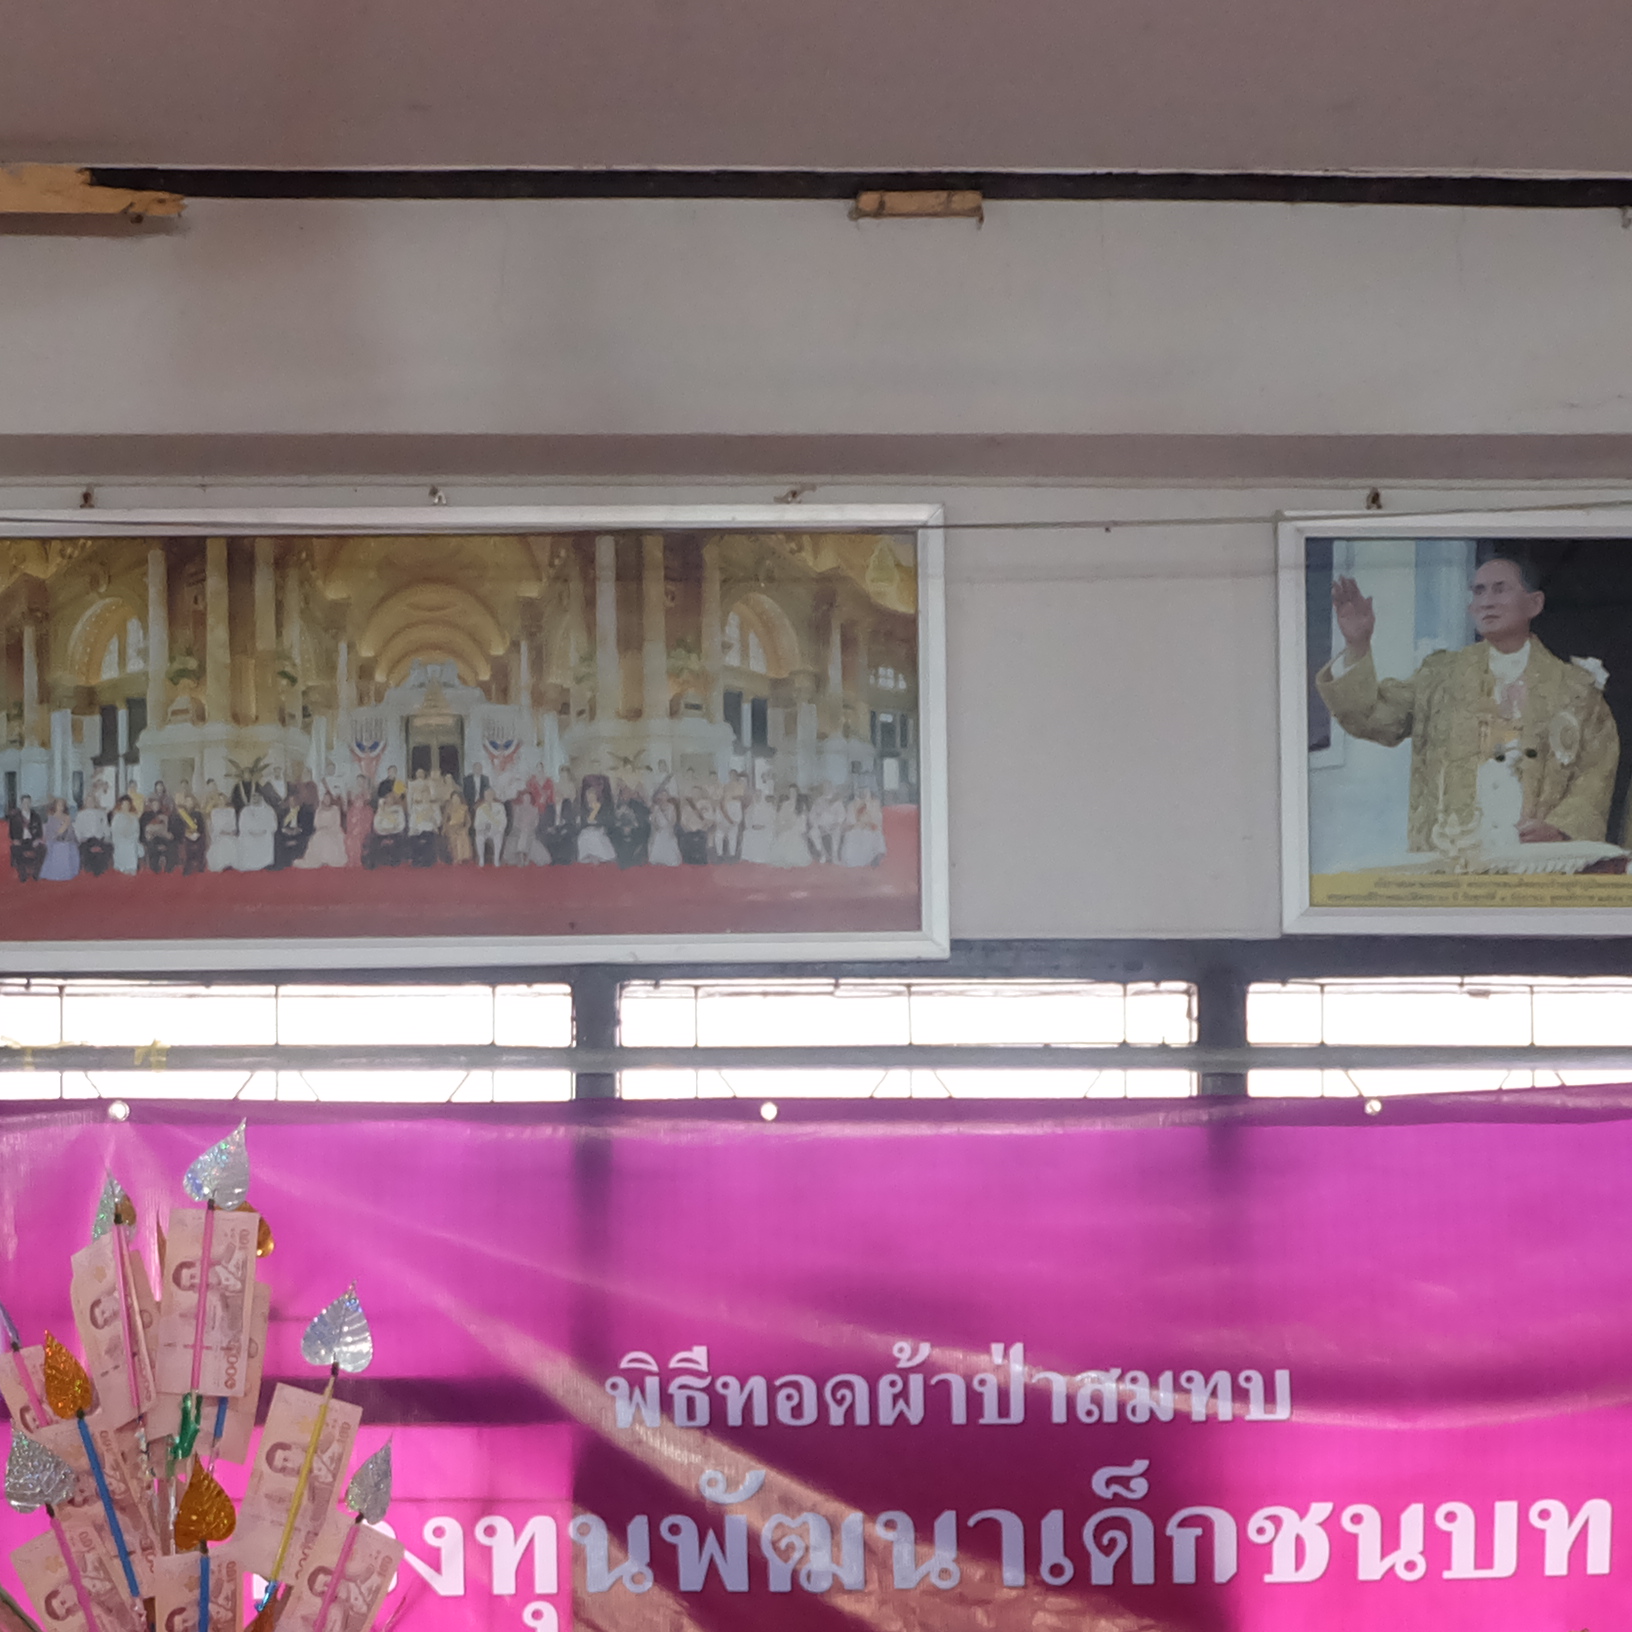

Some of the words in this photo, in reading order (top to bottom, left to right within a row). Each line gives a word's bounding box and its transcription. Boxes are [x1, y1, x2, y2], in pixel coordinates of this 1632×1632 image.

[605, 1340, 1293, 1428] พิธีทอดผ้าป่าสมทบ
